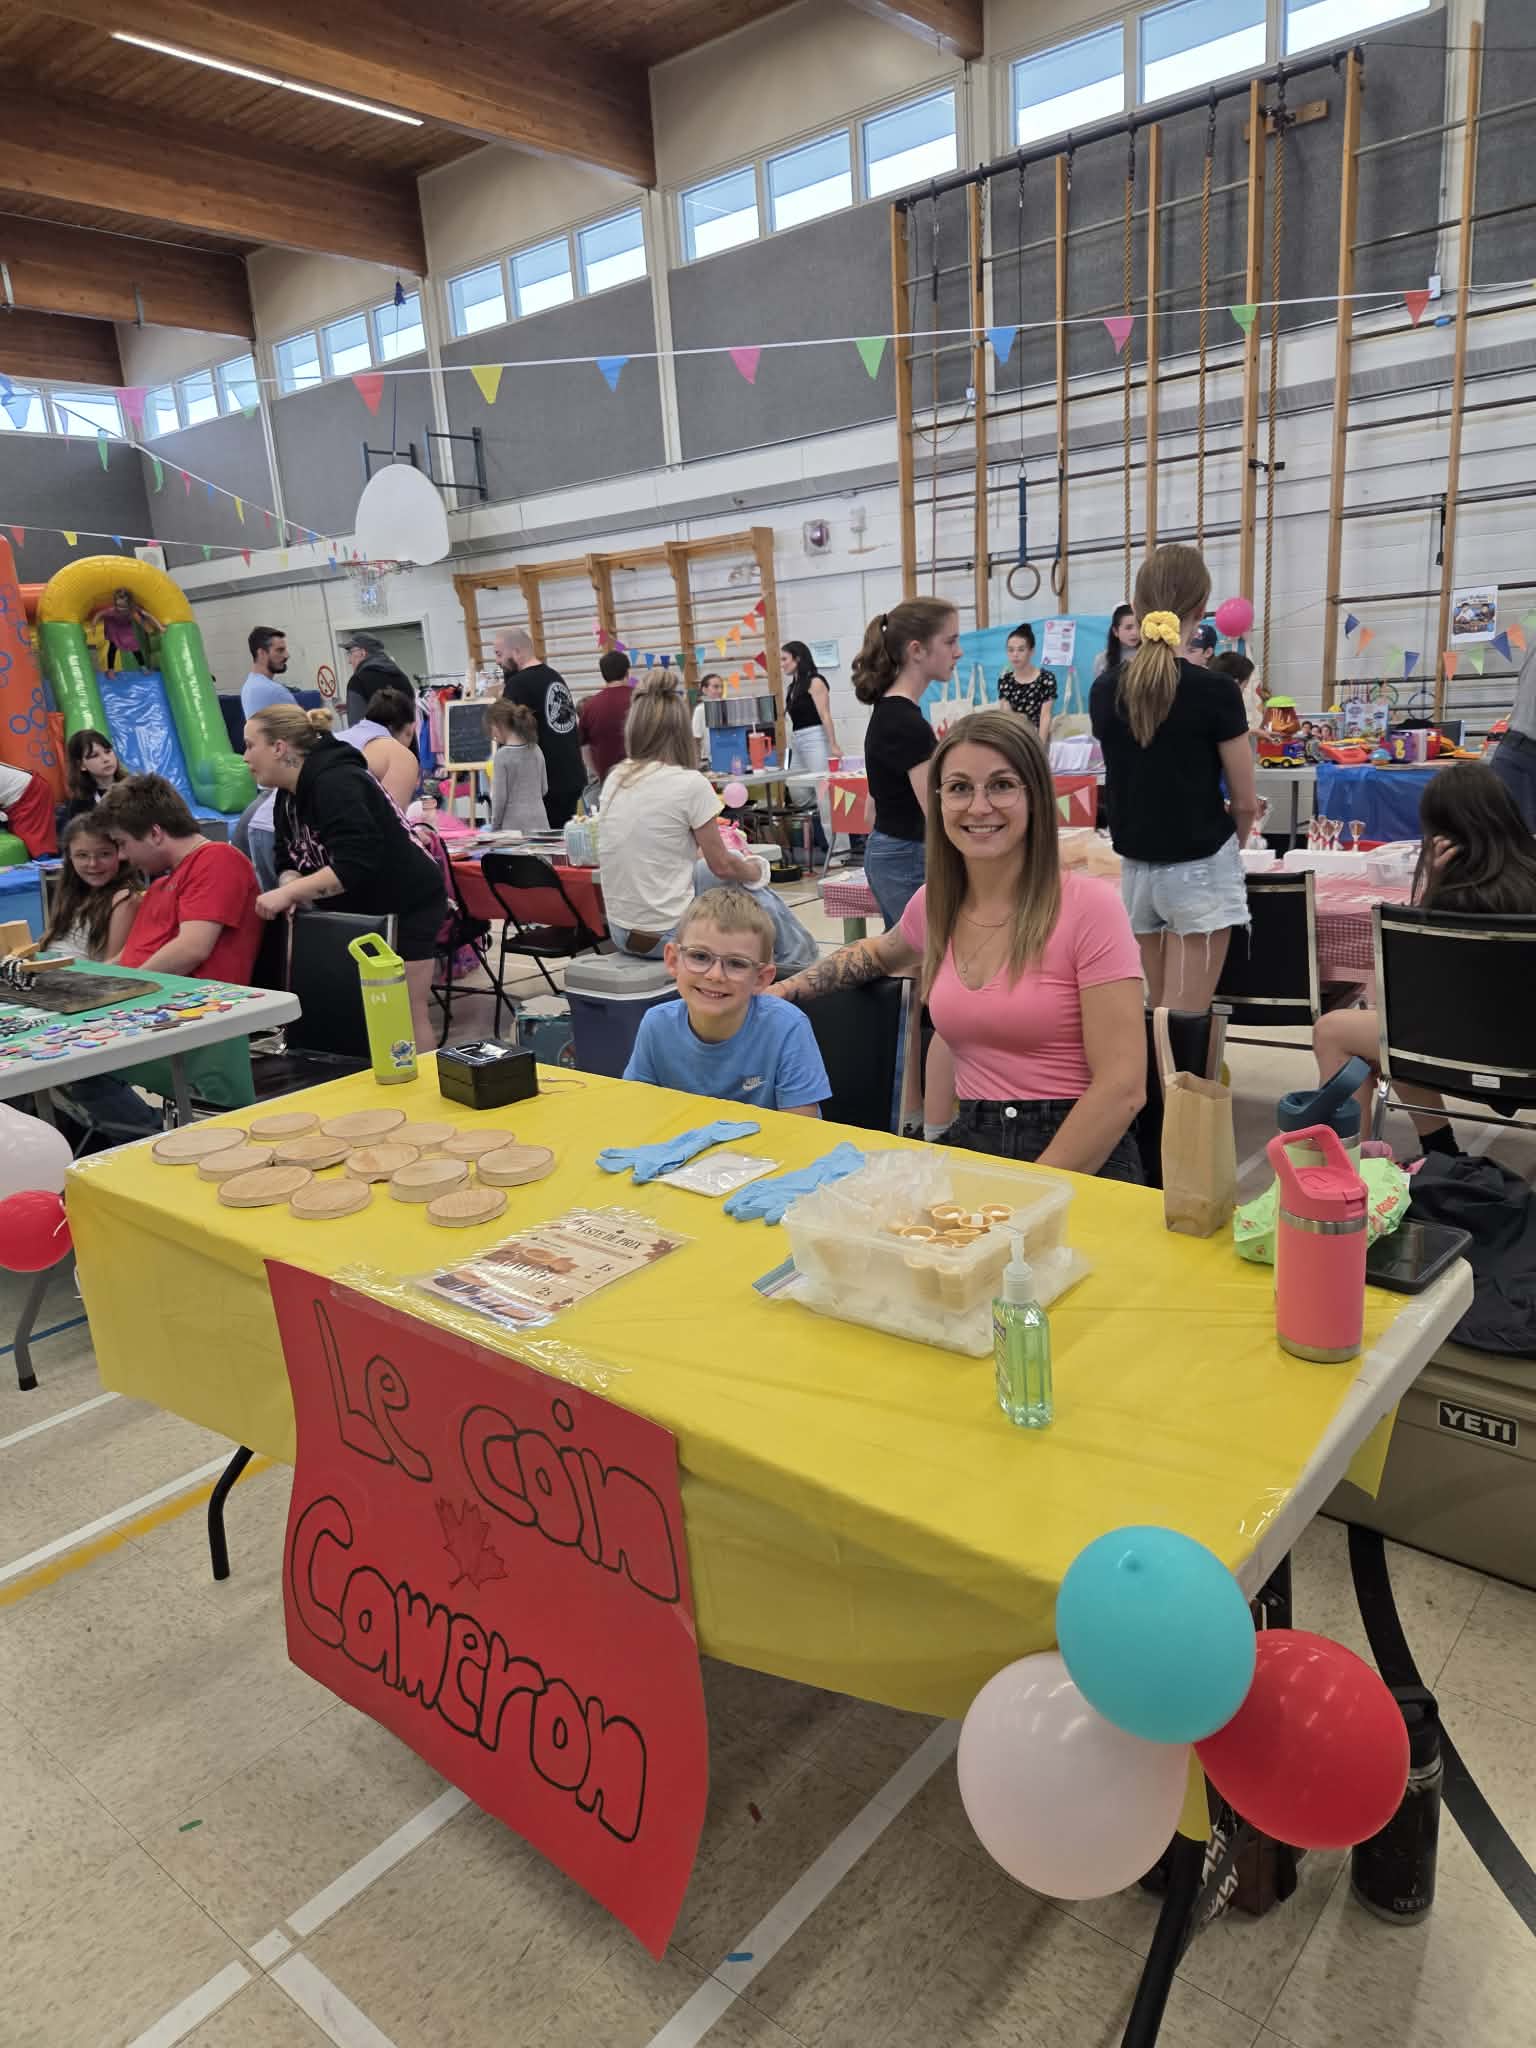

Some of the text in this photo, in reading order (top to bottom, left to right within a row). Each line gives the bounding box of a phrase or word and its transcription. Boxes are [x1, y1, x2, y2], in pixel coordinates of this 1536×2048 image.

[576, 1225, 605, 1238] LISTE
[616, 1237, 642, 1250] PRIX
[313, 1298, 433, 1483] Le
[1442, 1406, 1511, 1441] YETI
[291, 1495, 647, 1843] Cameron
